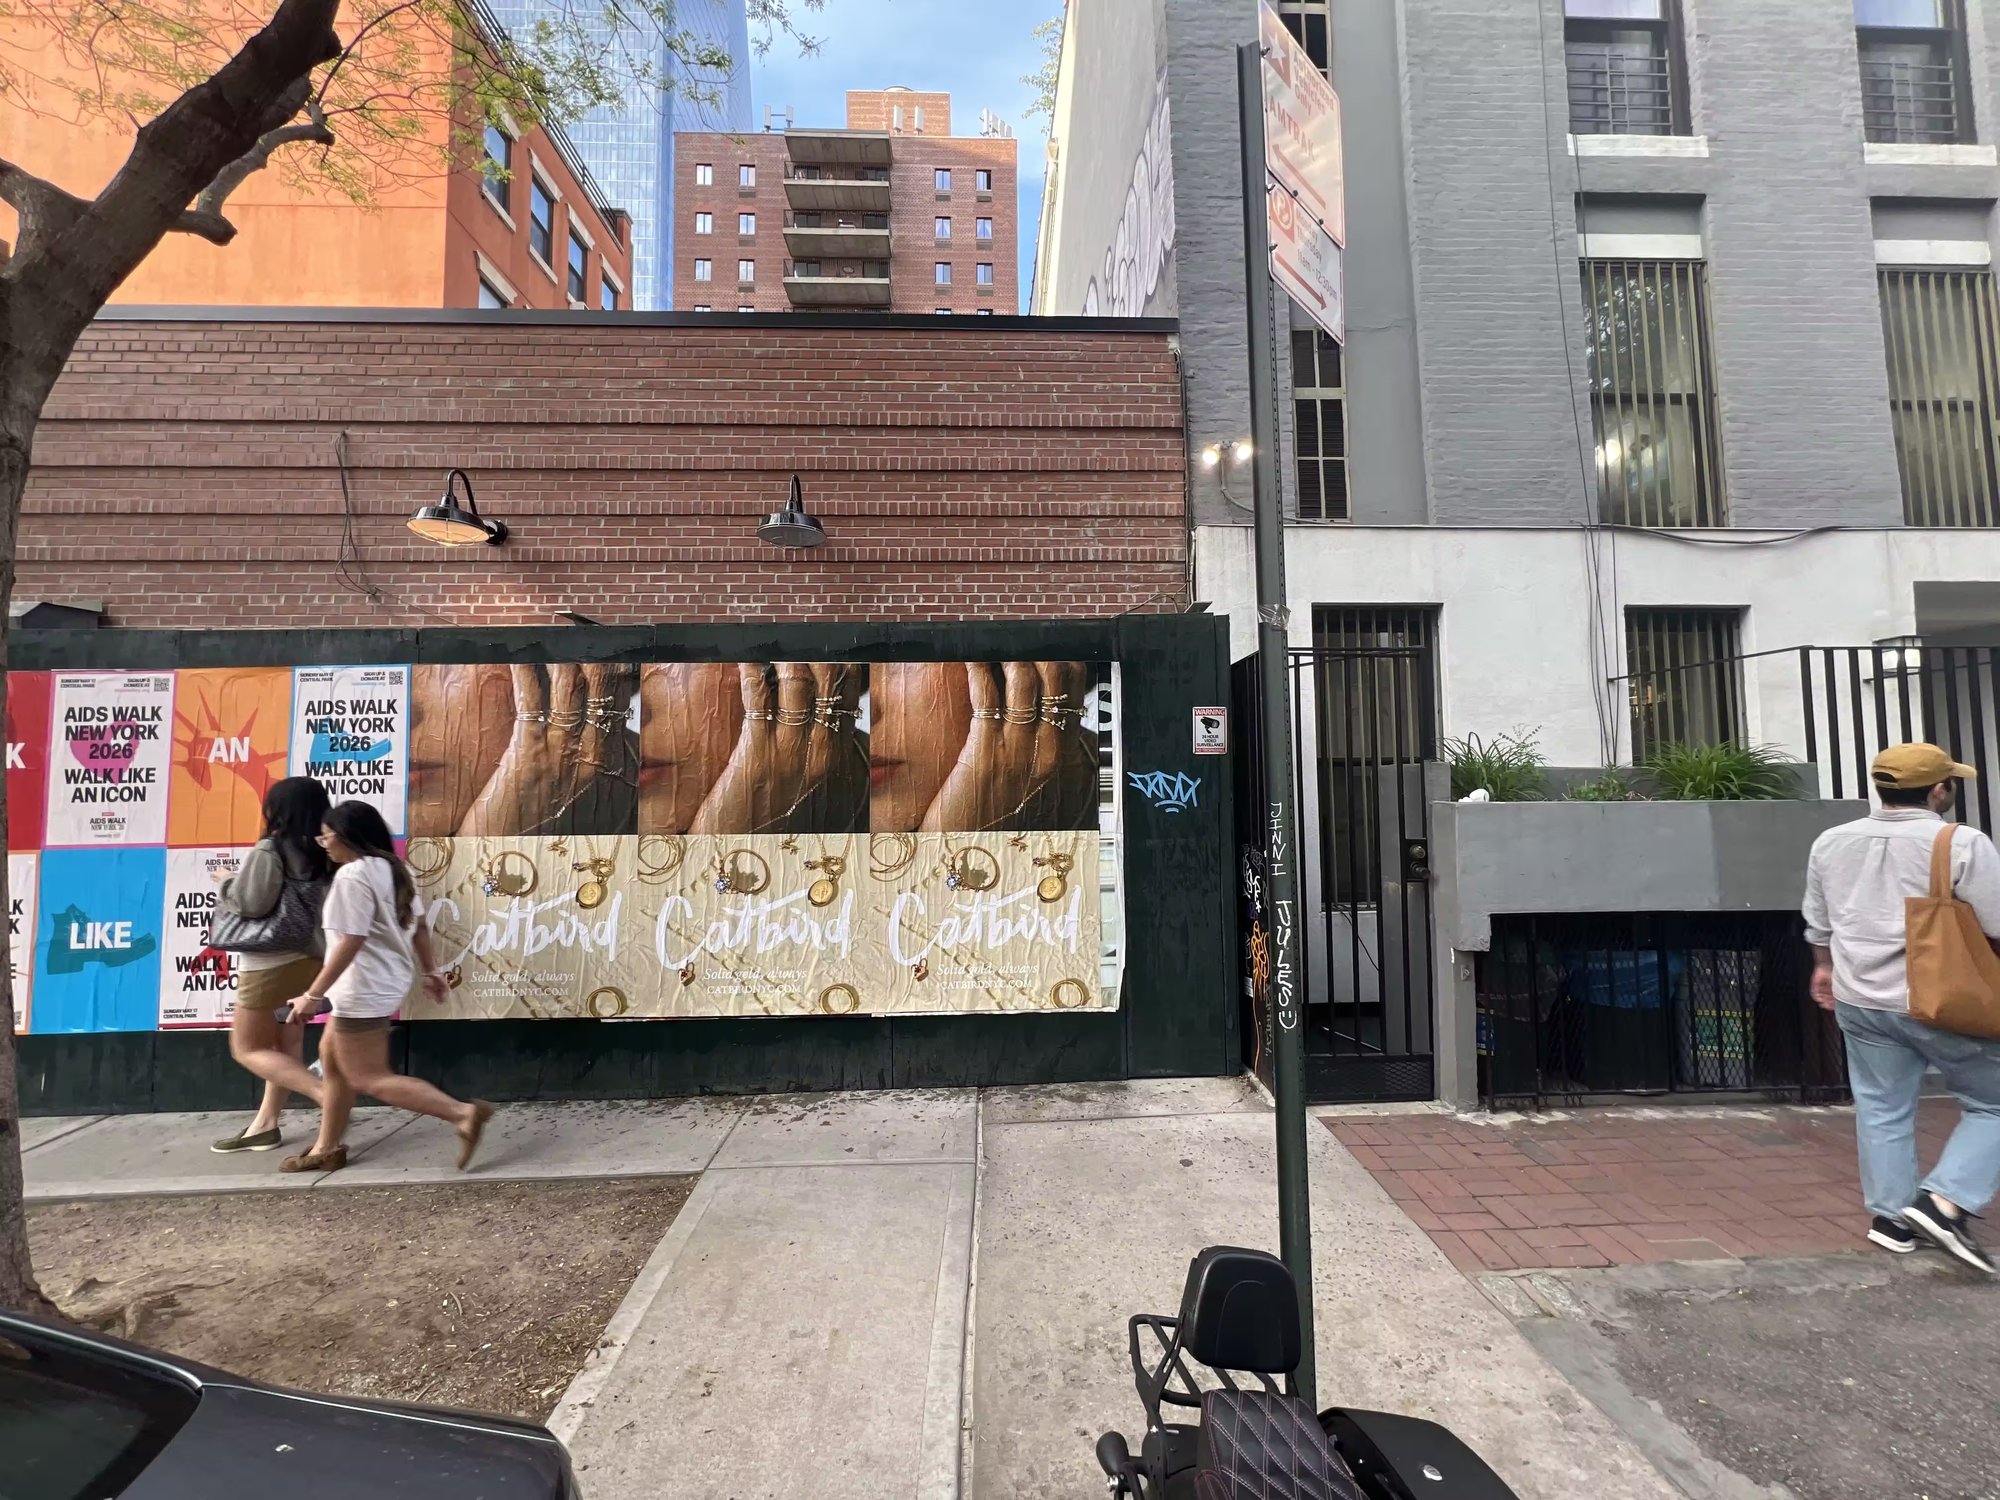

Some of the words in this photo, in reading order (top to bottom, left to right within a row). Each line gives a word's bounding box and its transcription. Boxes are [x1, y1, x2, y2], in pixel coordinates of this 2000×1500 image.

[1294, 50, 1334, 111] Authorized
[1294, 64, 1326, 115] Vehicles
[1295, 84, 1312, 116] Only
[1270, 95, 1315, 160] AMTRAK
[64, 706, 108, 722] AIDS
[112, 706, 163, 721] WALK
[305, 700, 347, 716] AIDS
[350, 699, 398, 715] WALK
[65, 724, 107, 741] NEW
[110, 724, 159, 740] YORK
[306, 718, 346, 734] NEW
[349, 717, 396, 733] YORK
[89, 743, 133, 760] 2026
[208, 736, 250, 763] AN
[329, 736, 372, 752] 2026
[64, 768, 115, 784] WALK
[118, 767, 156, 784] LIKE
[305, 760, 354, 776] WALK
[357, 760, 394, 776] LIKE
[71, 786, 98, 803] AN
[101, 786, 147, 803] ICON
[341, 779, 385, 795] ICON
[90, 817, 107, 825] AIDS
[205, 858, 221, 866] AIDS
[175, 892, 217, 909] AIDS
[177, 911, 214, 928] NEW
[889, 885, 1082, 966] Catbird
[70, 921, 132, 950] LIKE
[426, 890, 622, 973] Catbird
[655, 888, 854, 970] Catbird
[176, 955, 223, 972] WALK
[937, 963, 968, 976] Solid
[998, 963, 1038, 977] always
[471, 970, 501, 983] Solid
[534, 970, 576, 984] always
[704, 967, 733, 980] Solid
[767, 966, 807, 981] always
[182, 975, 207, 991] AN
[707, 984, 801, 994] CATBIRDNYC.COM
[940, 979, 1032, 990] CATBIRDNYC.COM
[473, 987, 569, 997] CATBIRDNYC.COM
